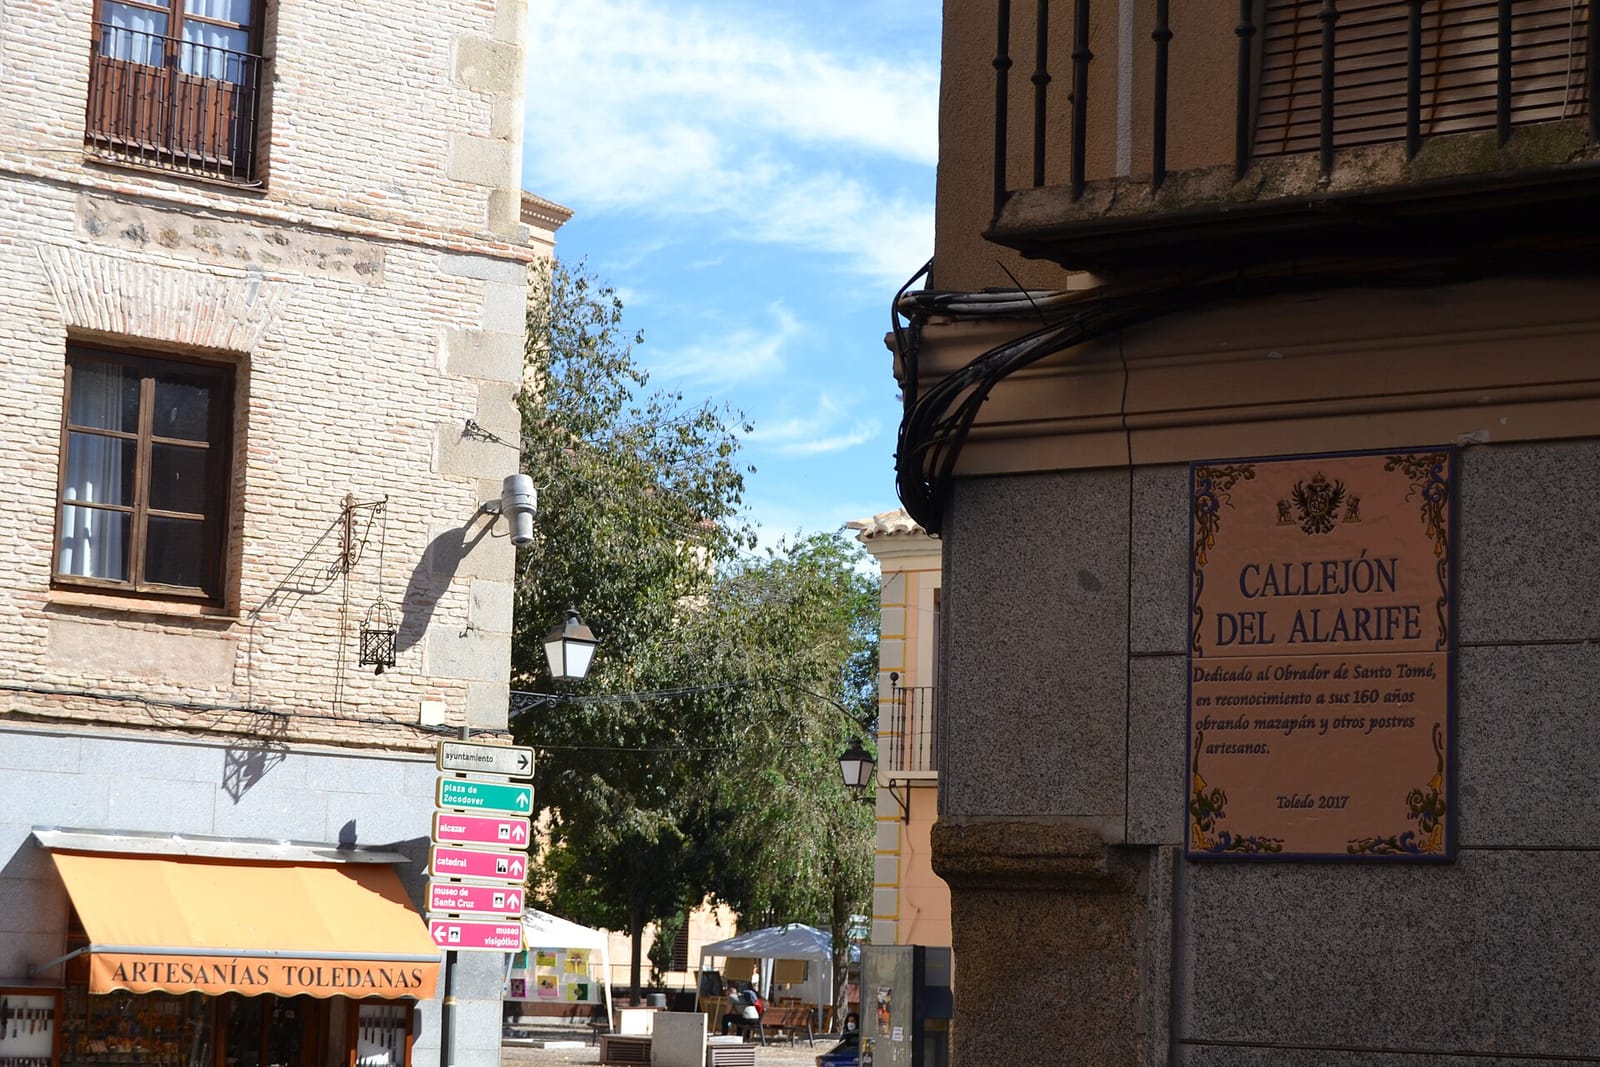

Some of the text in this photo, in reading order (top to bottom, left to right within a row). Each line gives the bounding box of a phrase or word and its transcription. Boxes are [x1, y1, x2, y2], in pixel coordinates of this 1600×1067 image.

[1239, 549, 1398, 598] CALLEJÓN
[1216, 605, 1422, 646] DEL ALARIFE
[1193, 662, 1436, 683] Dedicado al Obrador de Santo Tomé,
[1195, 688, 1415, 706] en reconocimiento a sus 160 años
[1195, 714, 1415, 736] obrando mazapán y otros postres
[1205, 742, 1270, 755] artesanos.
[445, 752, 493, 763] ayuntamiento
[444, 783, 478, 794] plaza de
[443, 794, 484, 805] Zocodover
[1276, 795, 1349, 809] Toledo 2017
[437, 857, 467, 867] catedral
[433, 887, 469, 896] museo de
[433, 897, 474, 908] Santa Cruz
[496, 927, 519, 935] museo
[112, 958, 422, 988] ARTESANÍAS TOLEDANAS
